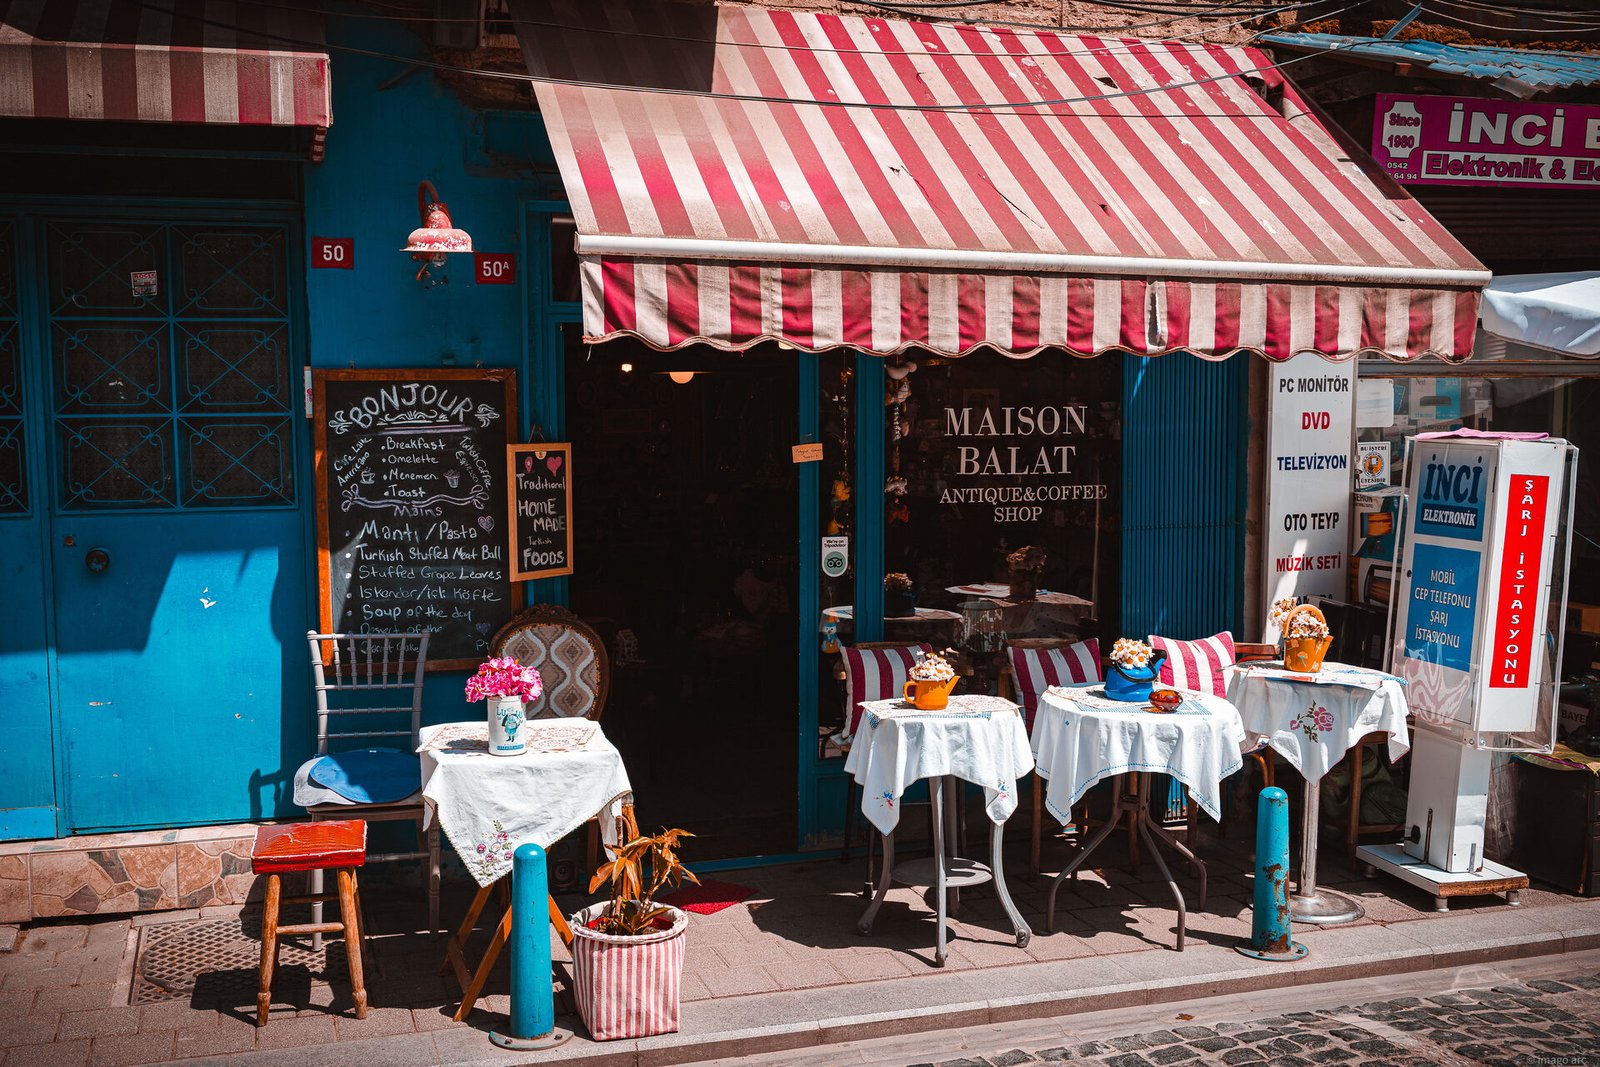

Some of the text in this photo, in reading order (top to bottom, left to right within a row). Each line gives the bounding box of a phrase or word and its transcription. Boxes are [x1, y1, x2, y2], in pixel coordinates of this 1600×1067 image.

[1389, 113, 1420, 127] Since
[1448, 102, 1565, 148] İNCİ
[1387, 134, 1415, 148] 1980
[1387, 162, 1408, 170] 0542
[1425, 153, 1545, 179] Elektronik
[1549, 158, 1567, 180] &
[323, 245, 344, 261] 50
[1279, 374, 1349, 393] PC MONİTÖR
[350, 382, 474, 429] BONJOUR
[944, 406, 1088, 436] MAISON
[1302, 412, 1331, 430] DVD
[386, 437, 446, 450] Breakfast
[388, 454, 440, 465] Omelette
[956, 446, 1076, 476] BALAT
[1277, 452, 1348, 471] TELEVİZYON
[389, 468, 438, 481] Menemen
[1423, 453, 1483, 504] İNCİ
[388, 484, 427, 498] Toast
[940, 484, 1108, 505] ANTIQUE&COFFEE
[394, 506, 443, 518] Mains
[994, 506, 1043, 522] SHOP
[1520, 479, 1534, 536] ŞARJ
[533, 516, 566, 532] MADE
[1284, 512, 1340, 532] OTO TEYP
[1423, 508, 1477, 528] ELEKTRONİK
[408, 546, 448, 560] Stuffed
[452, 548, 478, 560] Meat
[481, 546, 501, 560] Ball
[523, 548, 564, 571] FOODS
[1276, 552, 1342, 572] MÜZİK SETİ
[359, 565, 416, 580] Stuffed
[1430, 568, 1456, 586] MOBİL
[1414, 587, 1471, 608] CEP TELEFONU
[362, 604, 402, 621] Soup
[406, 605, 422, 618] of
[425, 606, 448, 618] the
[1430, 609, 1449, 627] ŞARJ
[1502, 552, 1525, 684] İSTASYONU
[1415, 624, 1460, 648] İSTASYONU
